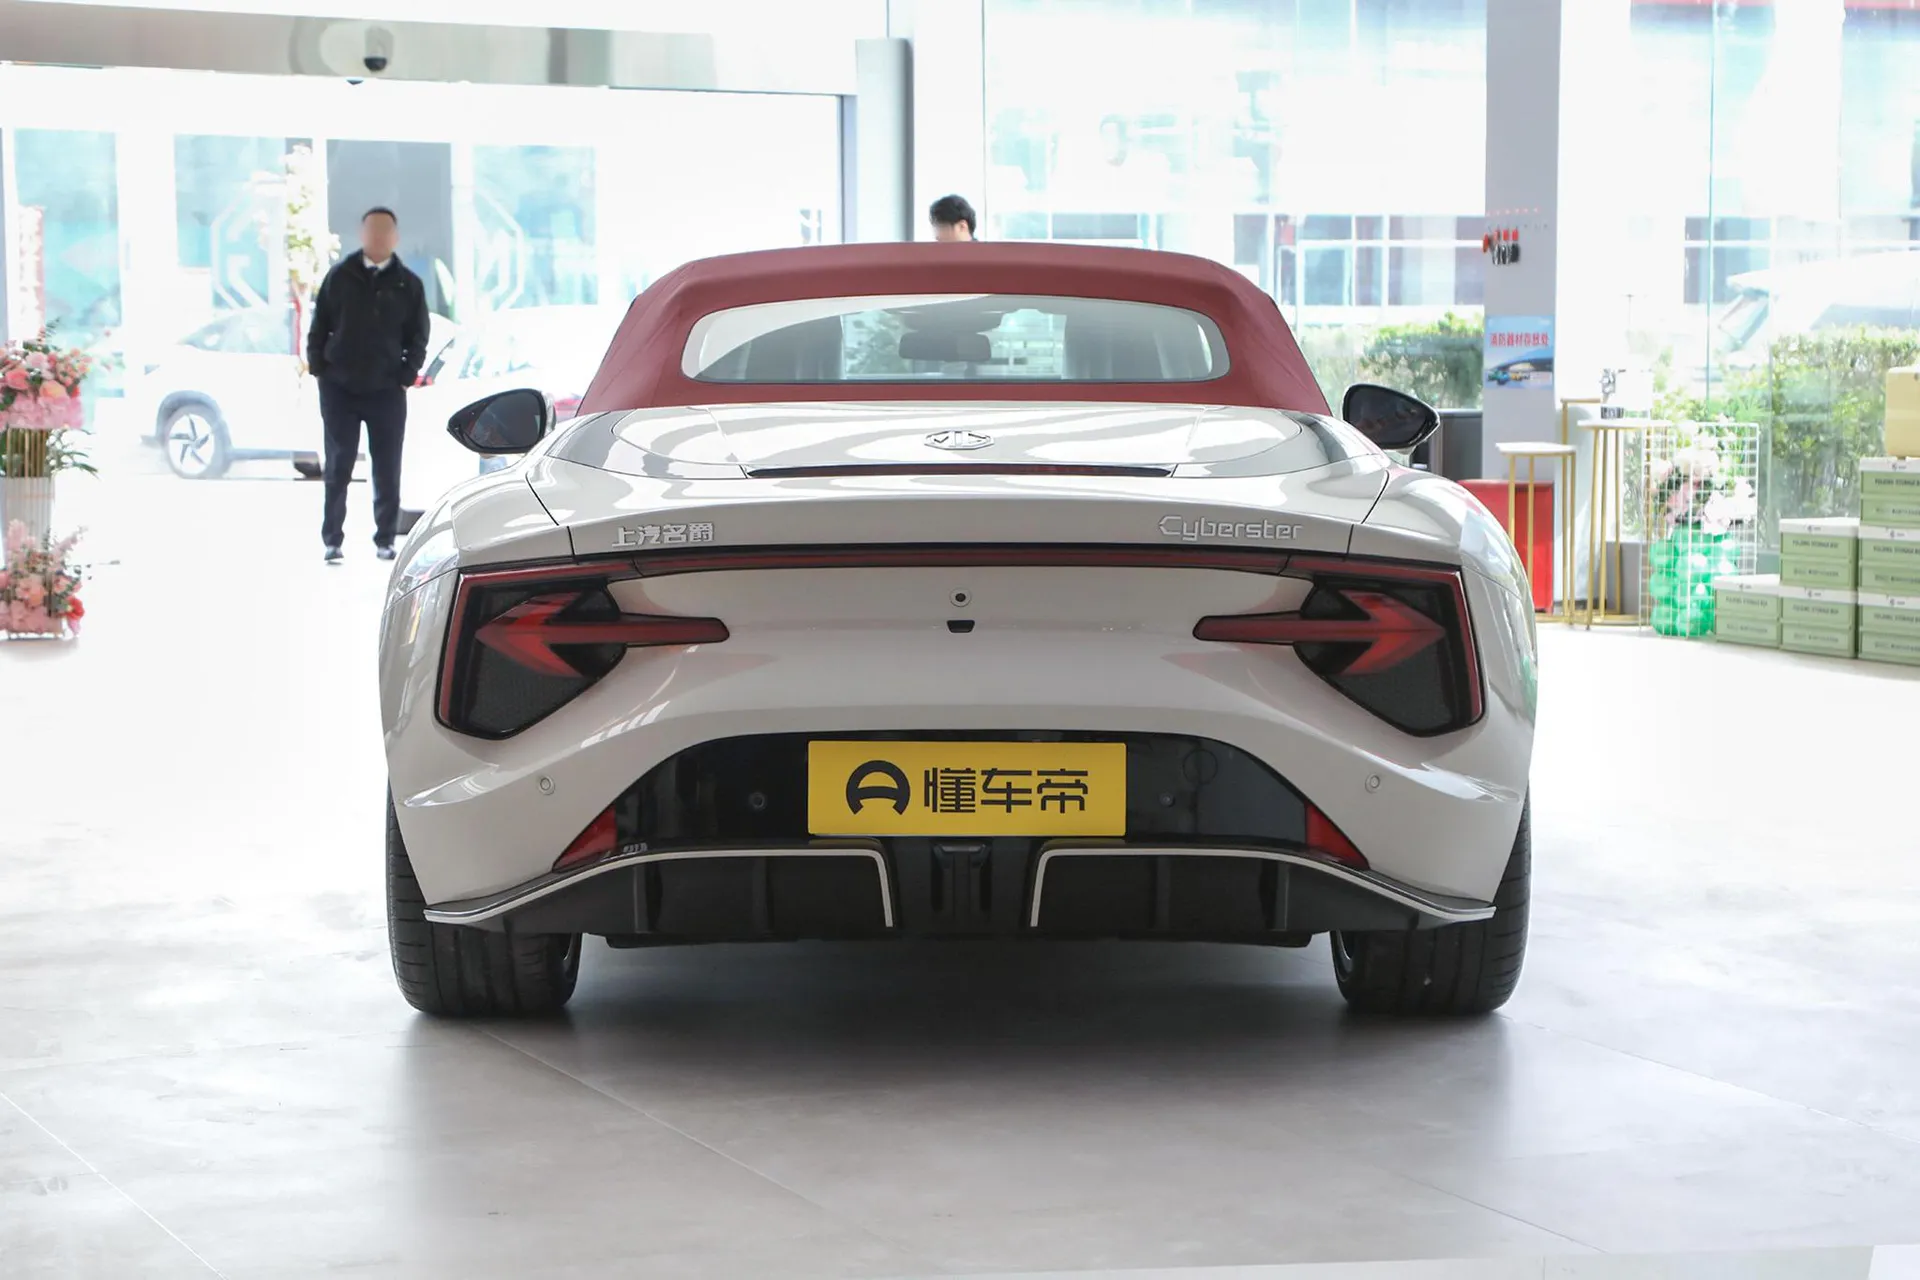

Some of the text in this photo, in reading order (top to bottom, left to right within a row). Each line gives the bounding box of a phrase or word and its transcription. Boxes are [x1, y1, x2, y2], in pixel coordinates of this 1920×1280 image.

[611, 522, 714, 547] 上汽名爵
[1159, 515, 1303, 541] Cyberster
[924, 767, 1088, 813] 懂车帝
